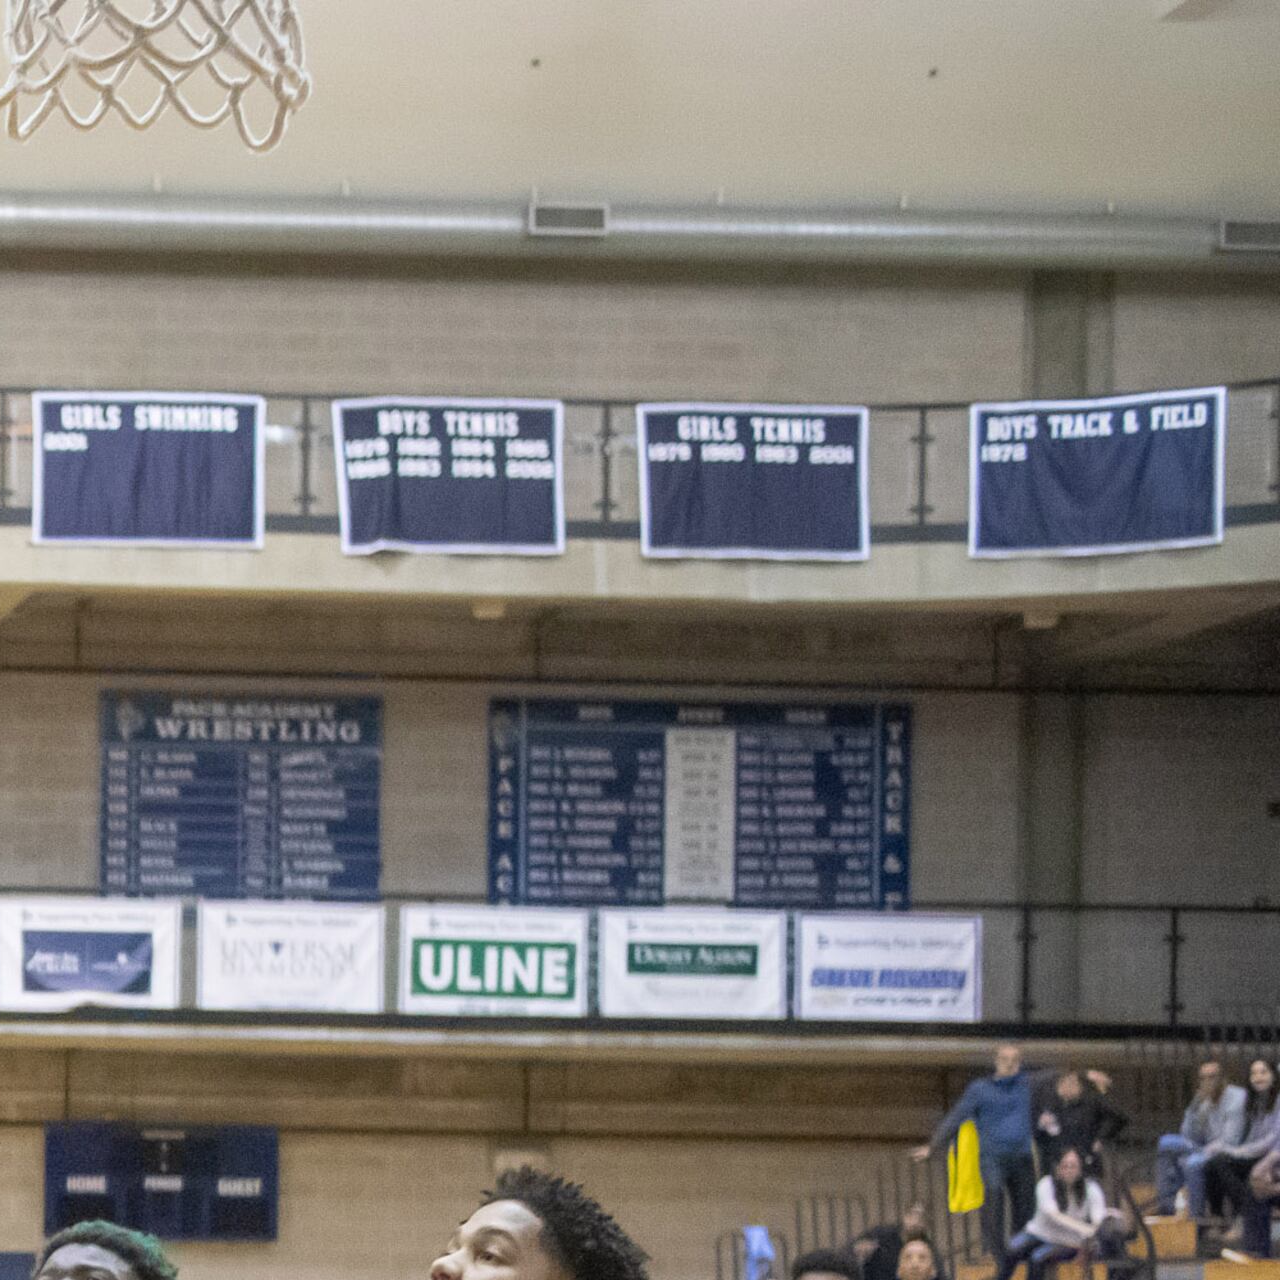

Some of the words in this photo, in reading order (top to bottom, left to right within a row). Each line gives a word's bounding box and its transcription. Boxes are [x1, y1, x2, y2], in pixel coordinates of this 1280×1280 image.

[61, 404, 121, 430] GIRLS
[135, 406, 238, 432] SWIMMING
[378, 409, 430, 436] BOYS
[444, 411, 519, 437] TENNIS
[678, 415, 737, 441] GIRLS
[750, 416, 825, 443] TENNIS
[987, 415, 1037, 441] BOYS
[1048, 412, 1113, 439] TRACK
[1124, 409, 1139, 434] &
[1151, 403, 1208, 430] FIELD
[154, 718, 361, 743] WRESTLING
[419, 943, 569, 995] ULINE
